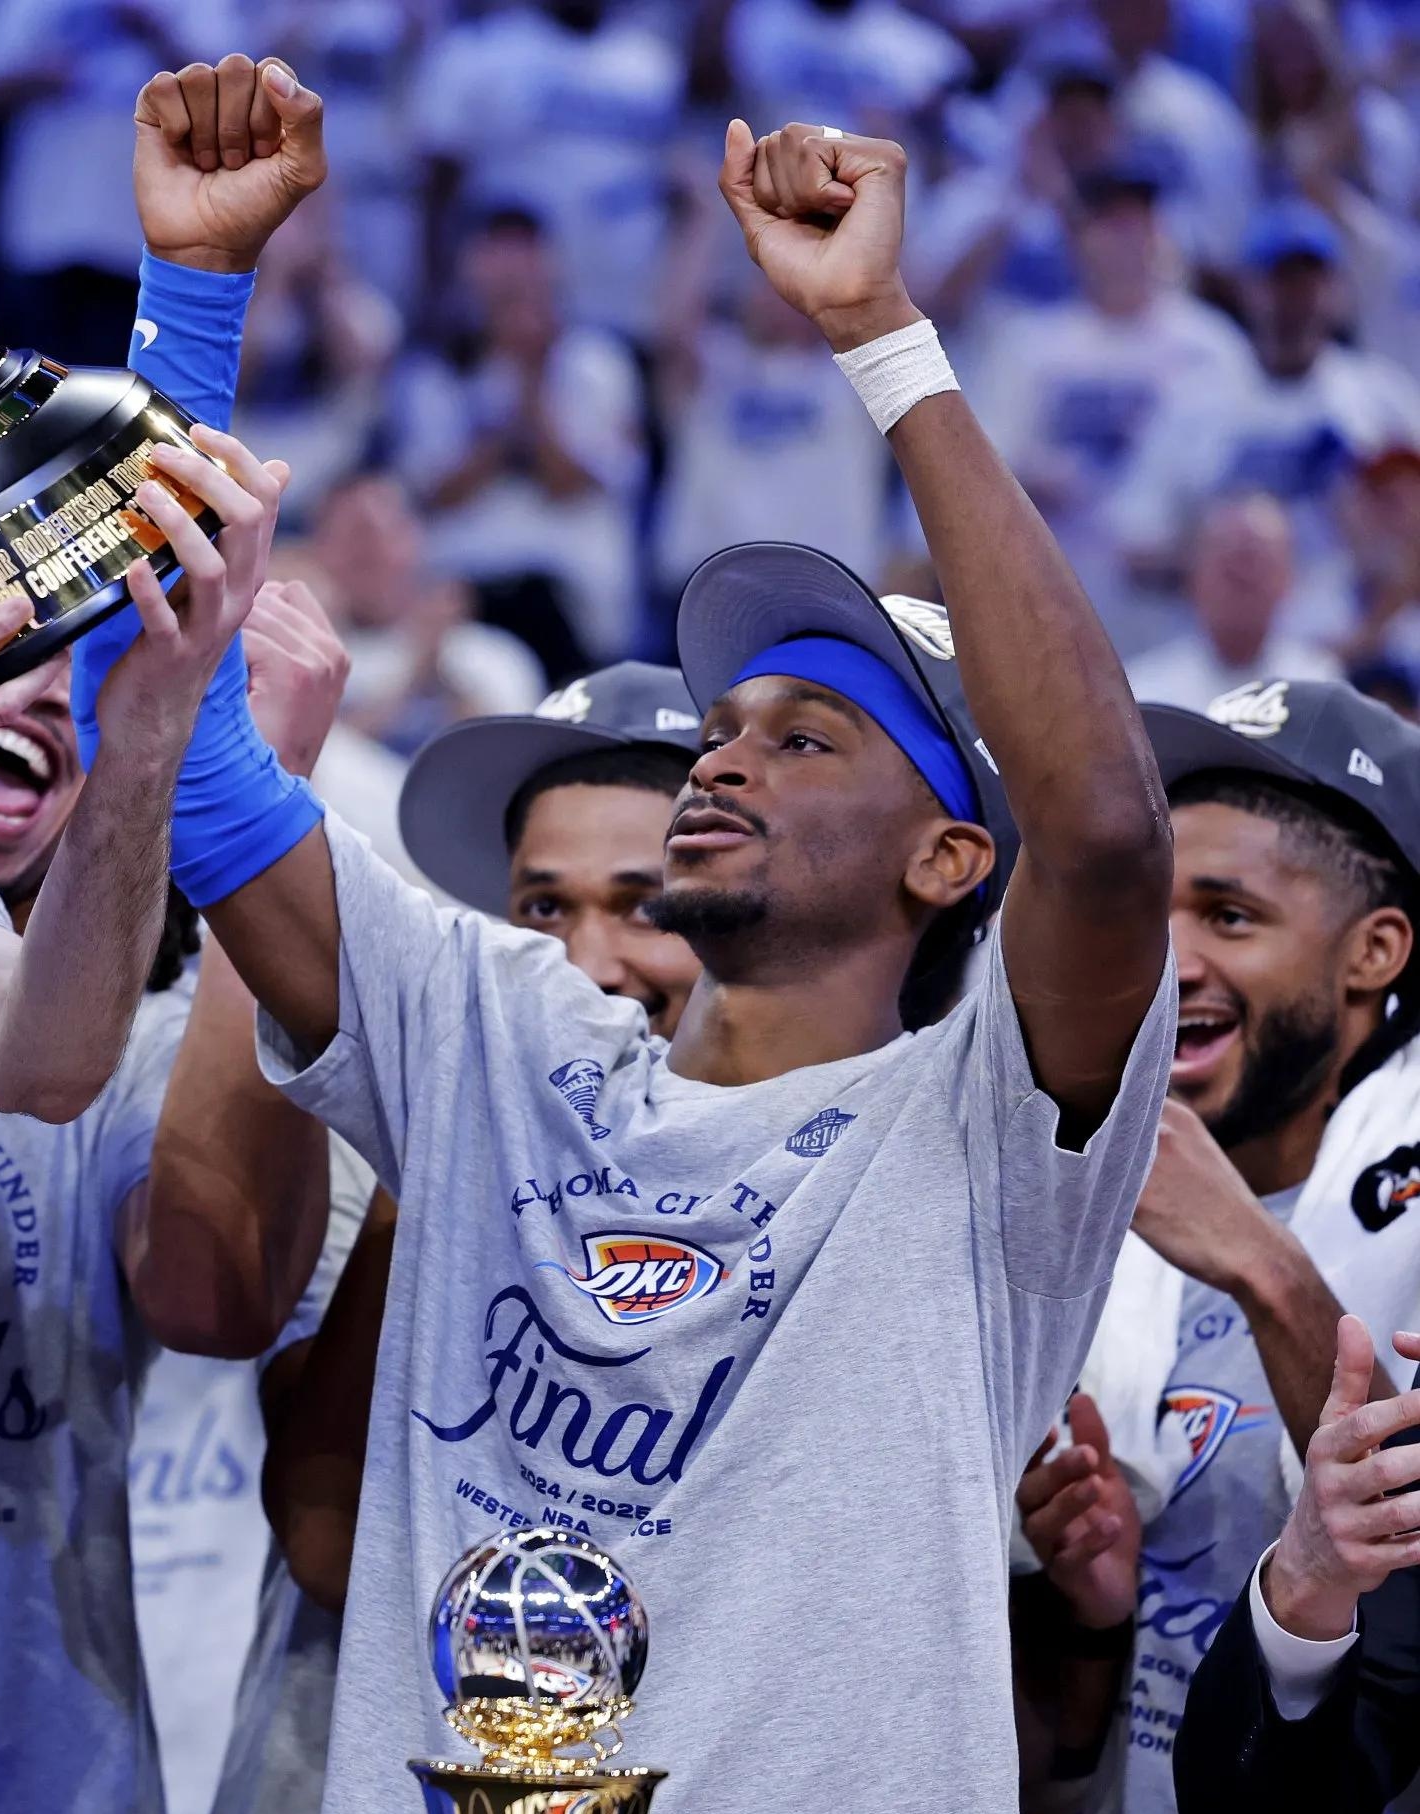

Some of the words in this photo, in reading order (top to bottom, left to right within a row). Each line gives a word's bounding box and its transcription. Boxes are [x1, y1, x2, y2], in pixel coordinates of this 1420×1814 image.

[10, 478, 123, 569] ROBERTSON
[106, 438, 157, 494] TROP
[25, 509, 139, 599] CONFERENCE
[580, 1258, 695, 1297] OKC
[655, 1193, 711, 1215] CI
[730, 1183, 777, 1322] THDER
[518, 1464, 561, 1499] 2024
[542, 1506, 592, 1537] NBA
